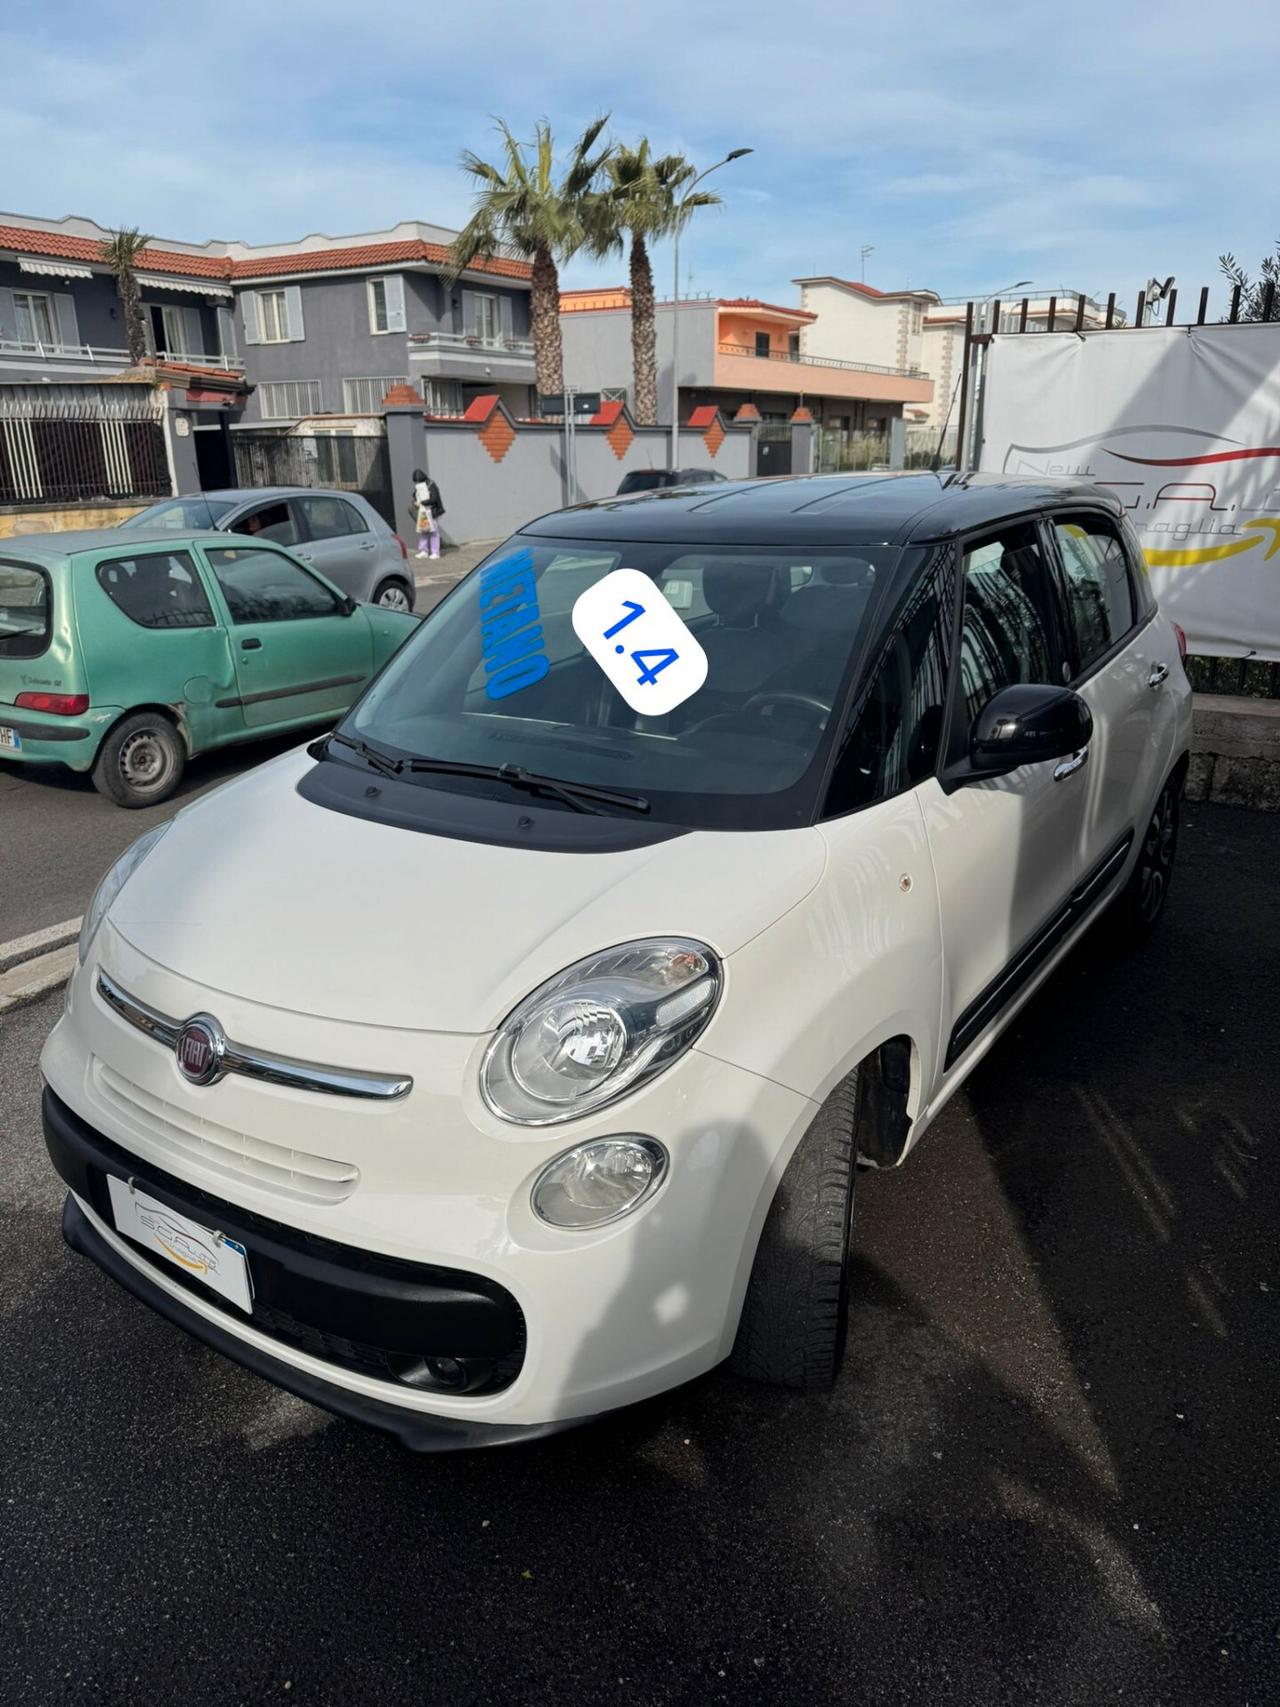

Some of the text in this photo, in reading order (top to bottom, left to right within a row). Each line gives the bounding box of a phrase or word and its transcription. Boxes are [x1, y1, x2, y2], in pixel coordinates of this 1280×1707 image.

[1016, 459, 1096, 476] New
[480, 547, 549, 699] METANO
[184, 1037, 208, 1067] FIAT
